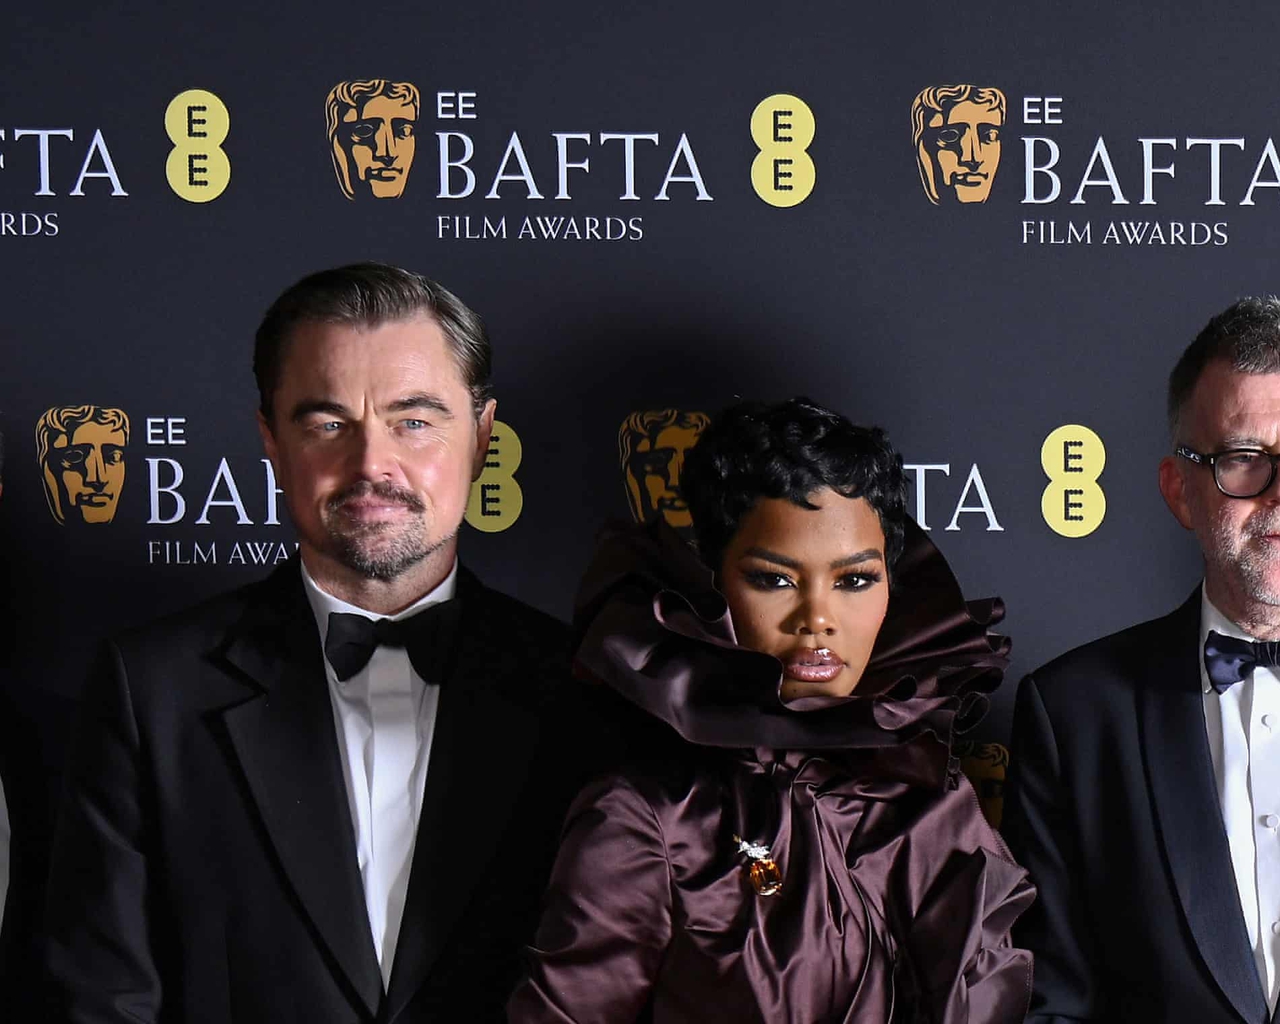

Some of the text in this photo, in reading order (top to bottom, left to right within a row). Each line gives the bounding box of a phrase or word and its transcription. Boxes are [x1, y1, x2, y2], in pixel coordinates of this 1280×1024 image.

[437, 91, 477, 119] EE
[1023, 97, 1063, 124] EE
[0, 128, 129, 197] TA
[435, 131, 714, 201] BAFTA
[437, 215, 643, 241] FILM AWARDS
[1022, 220, 1228, 246] FILM AWARDS
[146, 417, 187, 445] EE
[148, 541, 300, 565] FILM AWA
